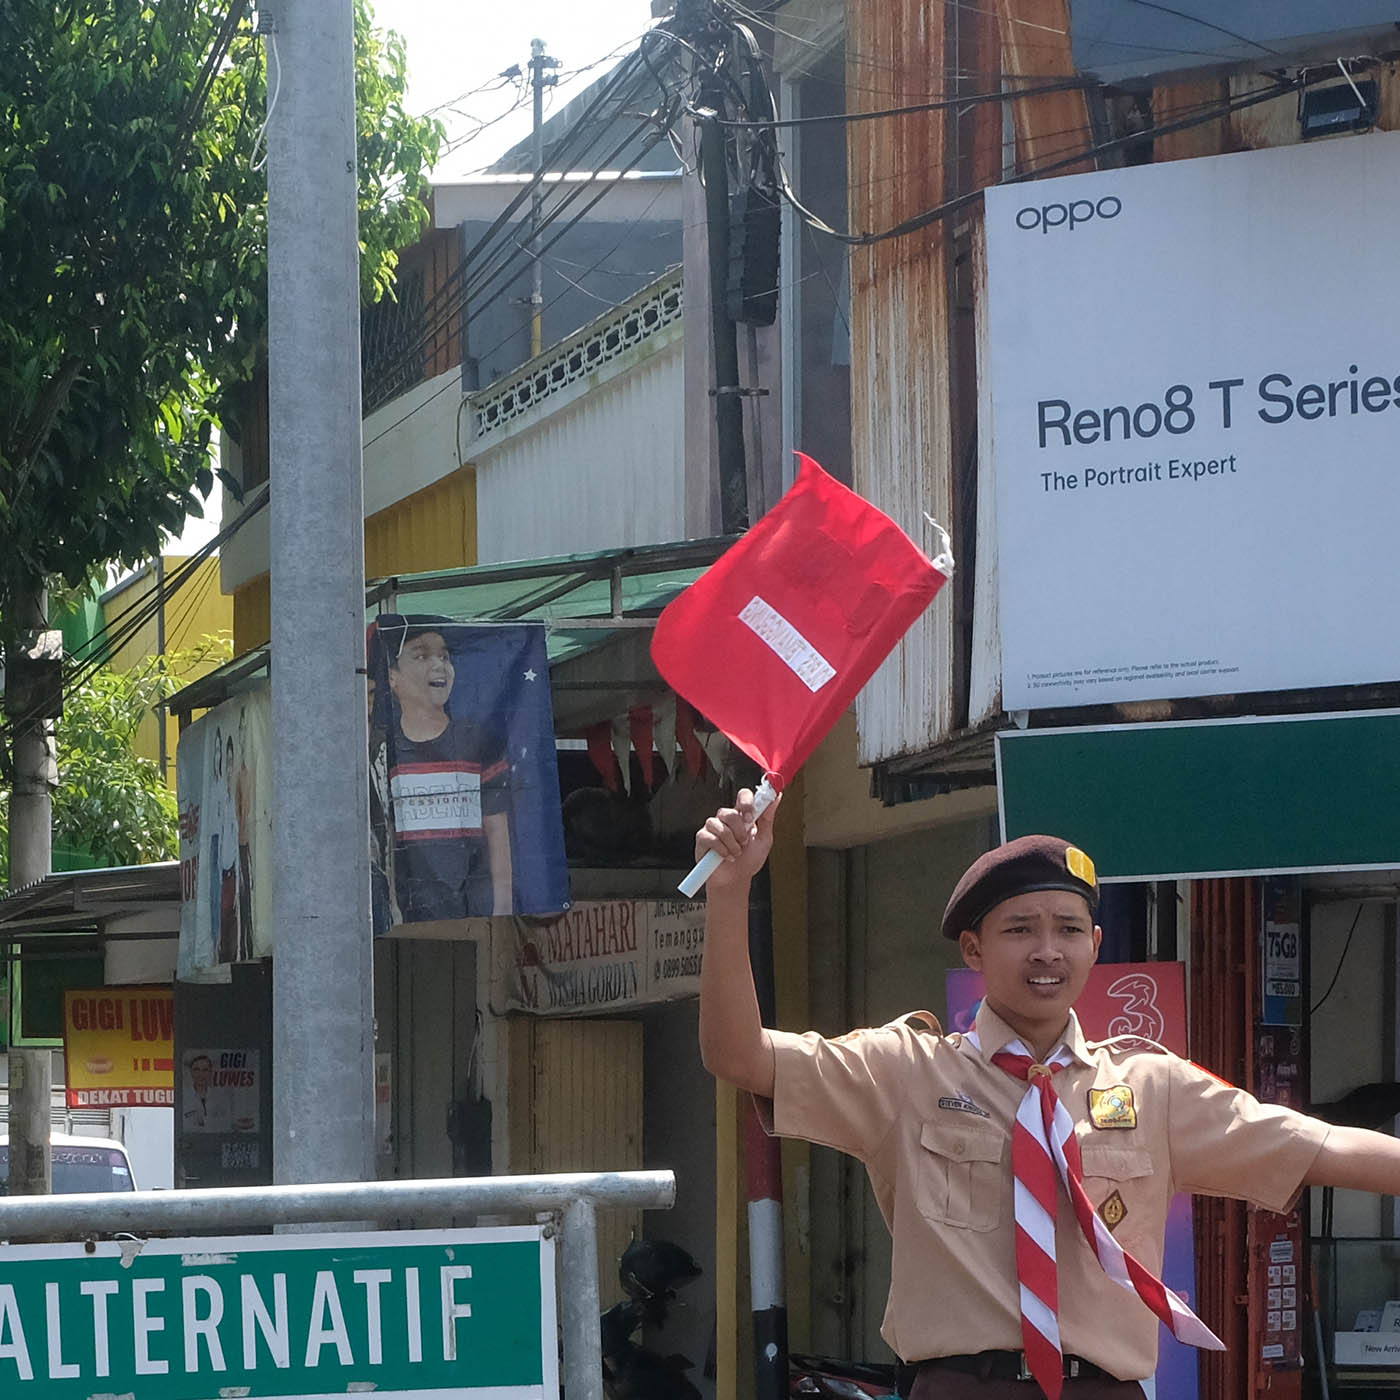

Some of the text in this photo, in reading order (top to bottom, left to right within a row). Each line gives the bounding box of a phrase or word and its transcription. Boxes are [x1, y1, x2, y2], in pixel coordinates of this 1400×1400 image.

[1015, 195, 1122, 234] oppo
[1037, 384, 1196, 449] Reno8
[1208, 378, 1245, 429] T
[1041, 454, 1238, 492] The Portrait Expert
[547, 901, 638, 963] MATAHARI
[71, 998, 124, 1031] GIGI
[219, 1052, 248, 1069] GIGI
[77, 1089, 131, 1105] DEKAT
[1365, 1344, 1382, 1353] New
